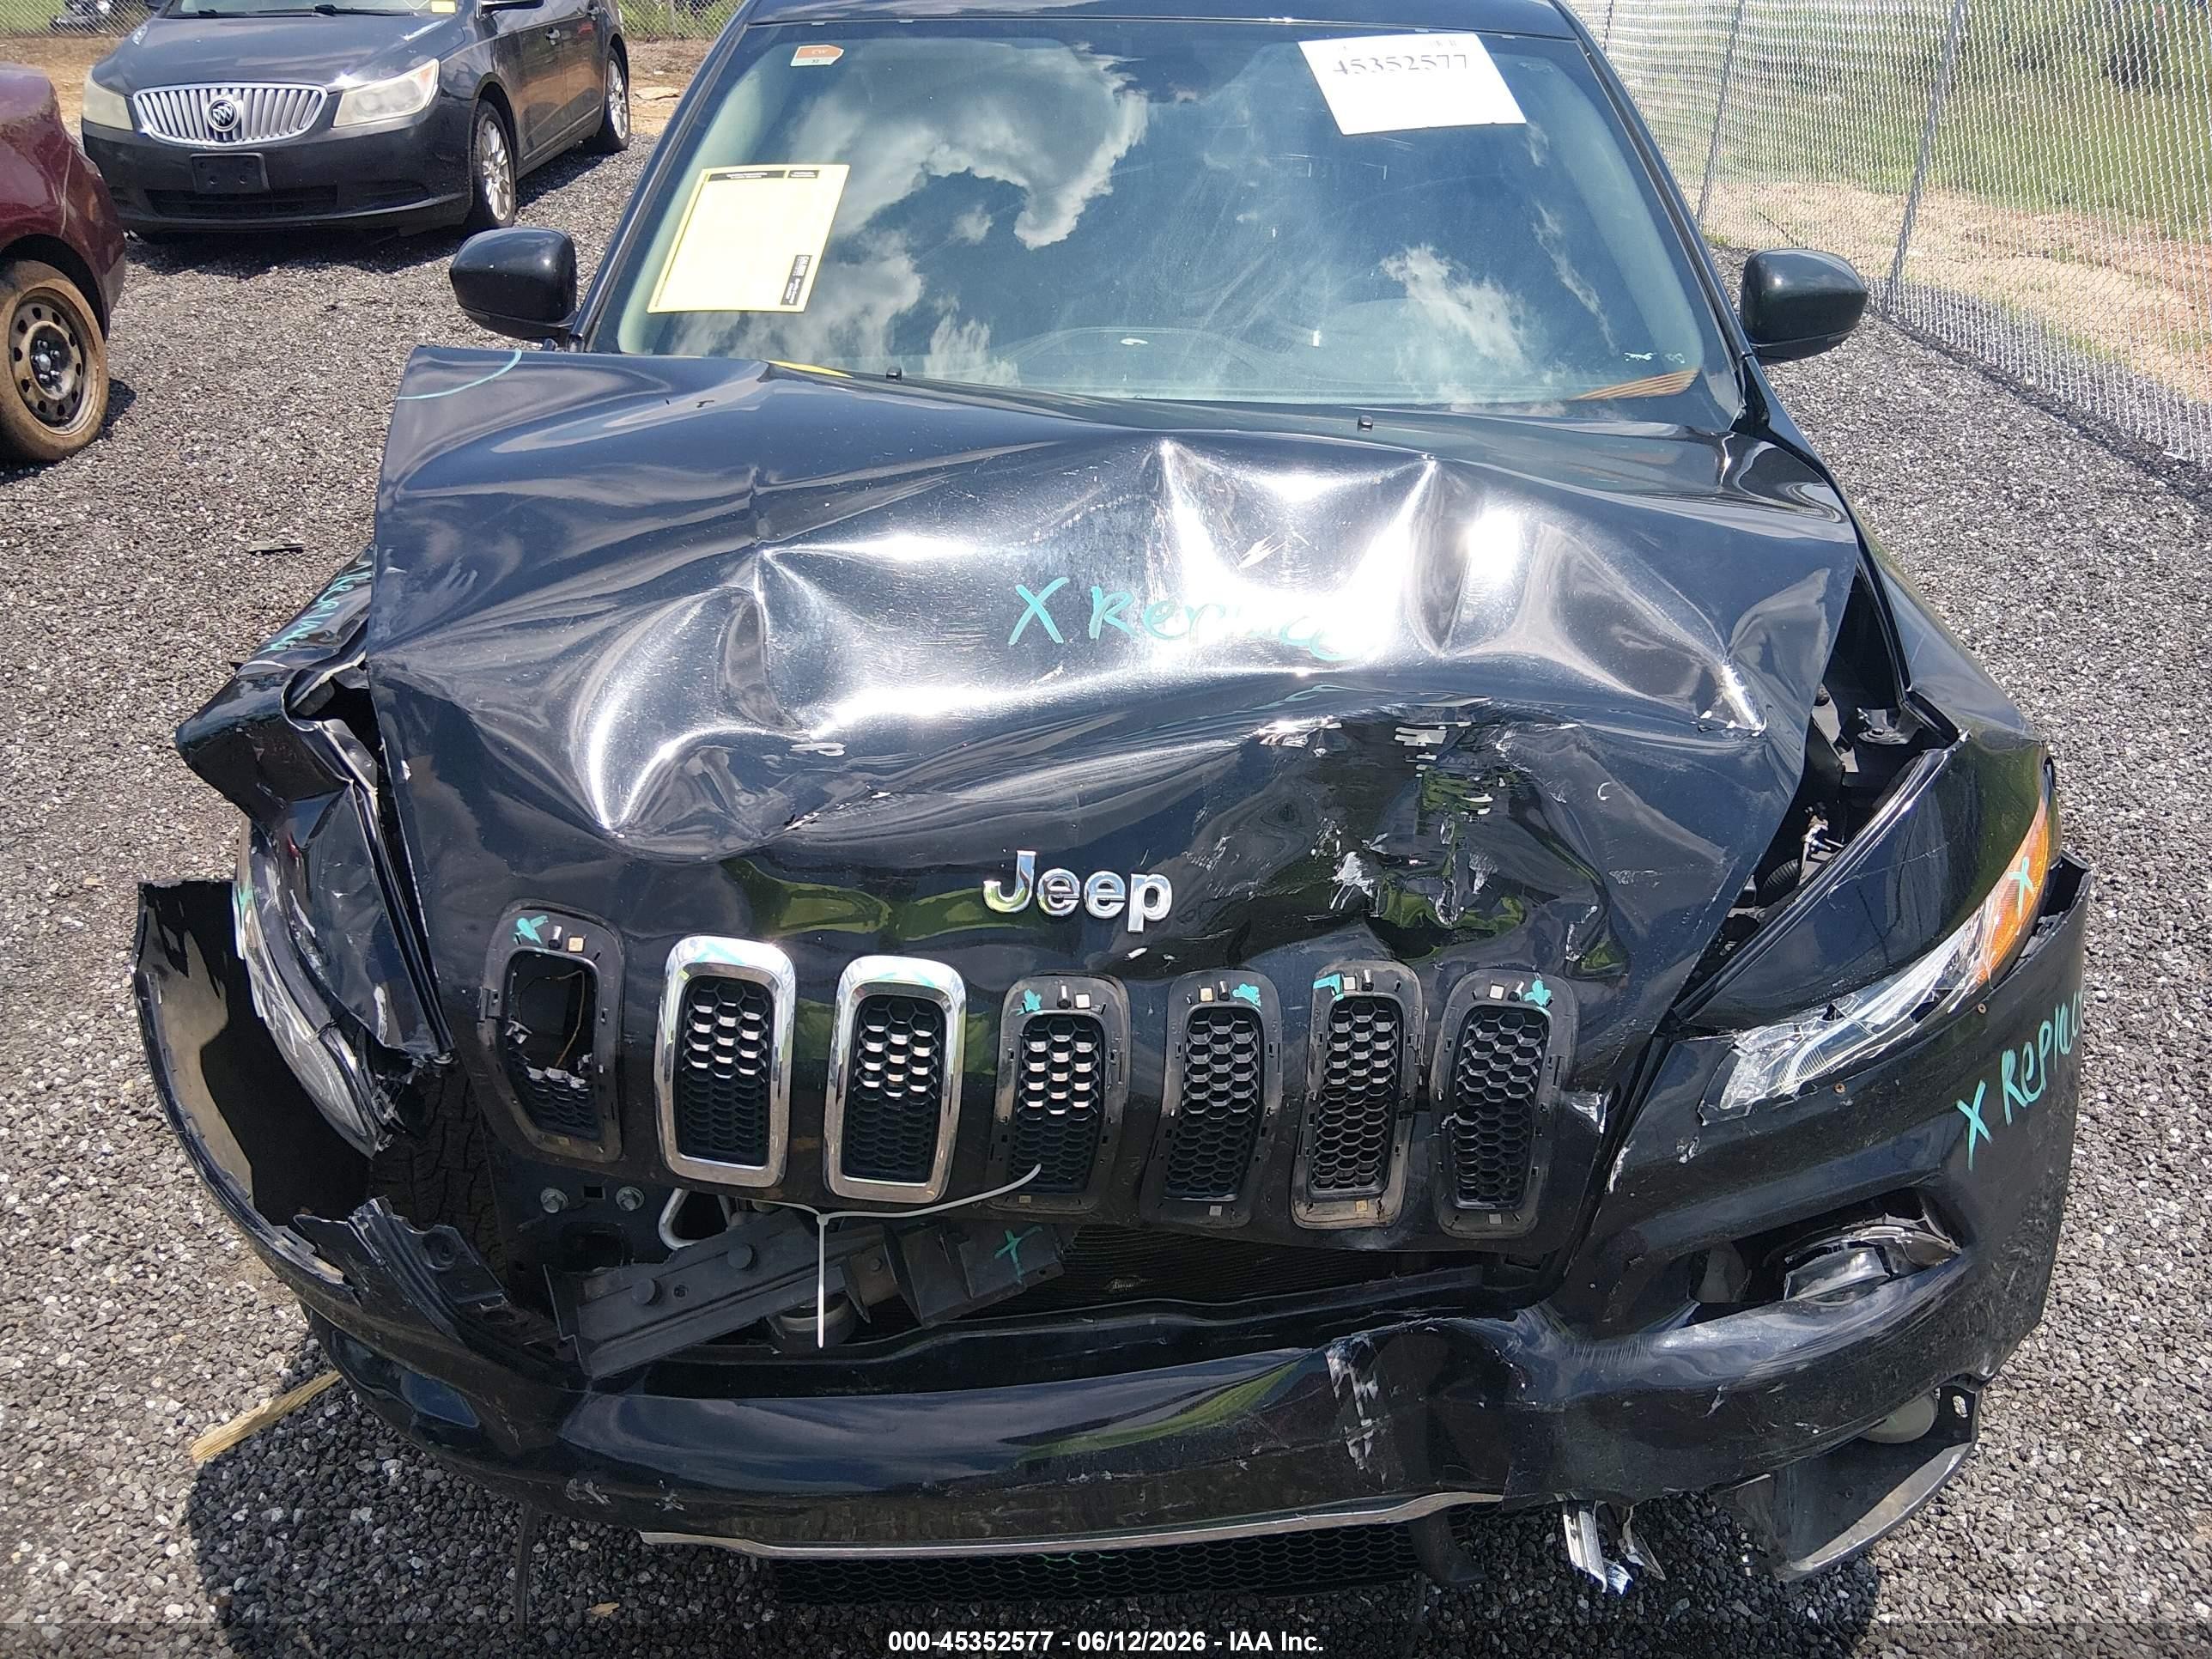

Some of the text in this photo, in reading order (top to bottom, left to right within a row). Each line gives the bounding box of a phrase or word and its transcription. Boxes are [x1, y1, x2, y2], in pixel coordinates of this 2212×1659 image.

[1332, 53, 1468, 76] 45352577
[1008, 577, 1069, 645] X
[982, 849, 1173, 933] Jeep
[1956, 1079, 1993, 1172] X
